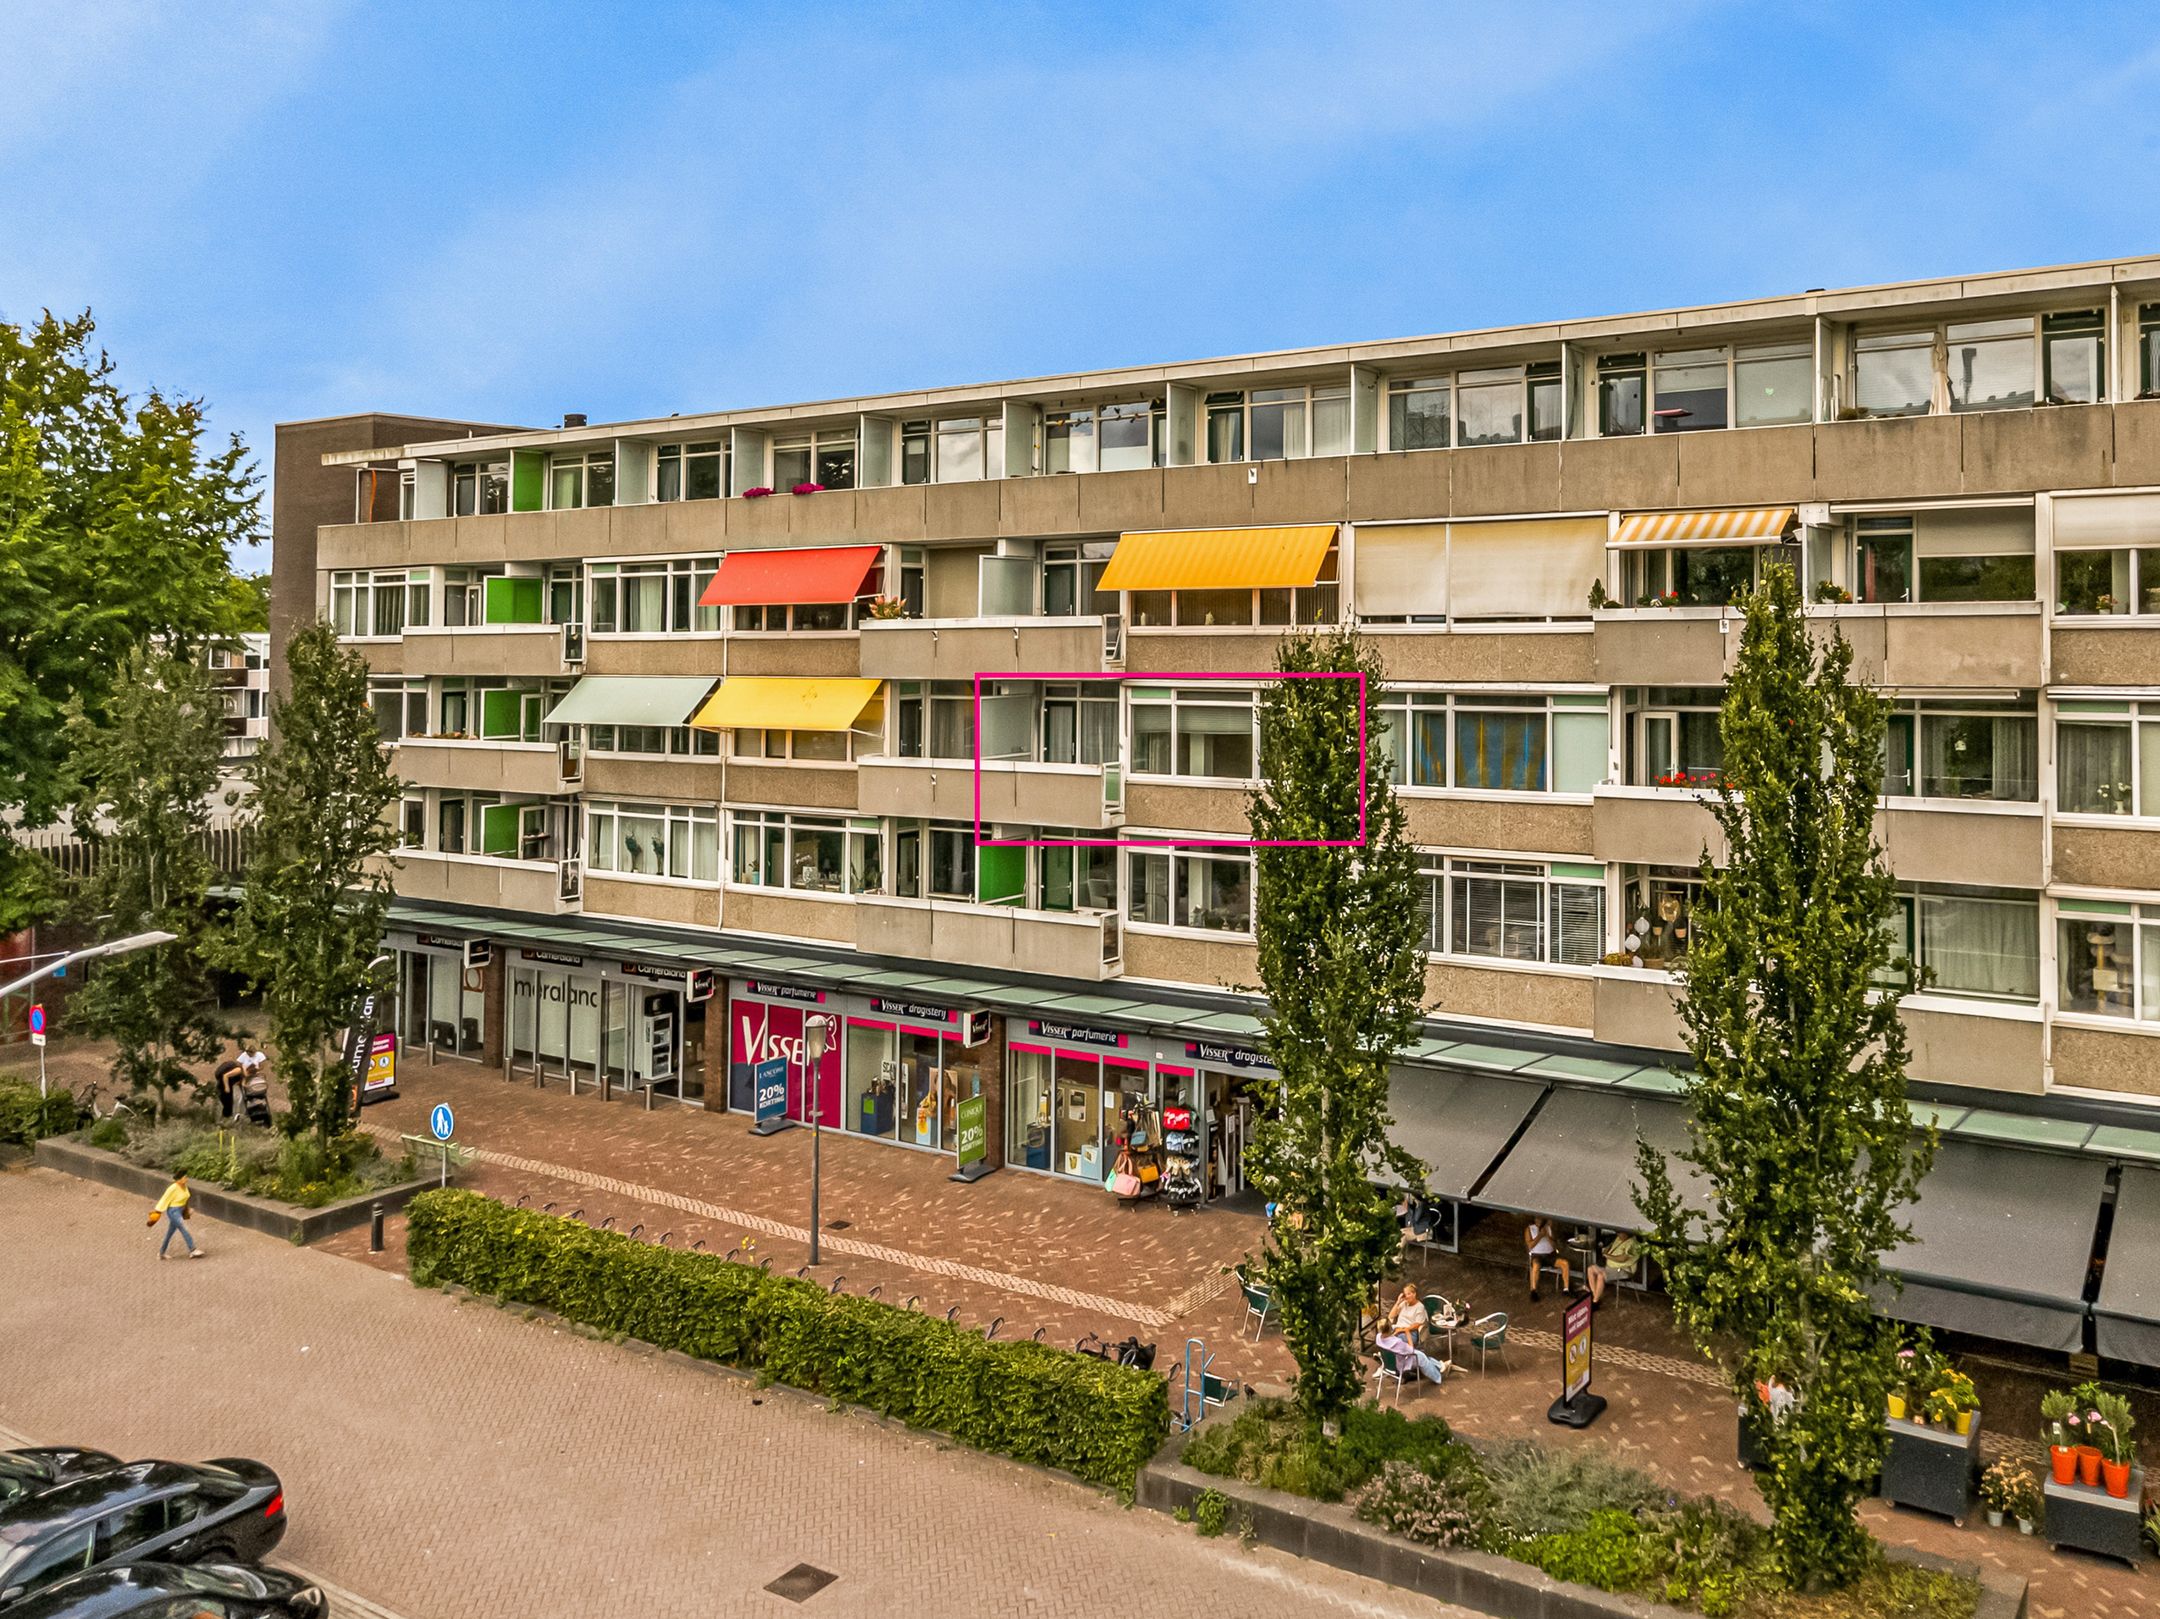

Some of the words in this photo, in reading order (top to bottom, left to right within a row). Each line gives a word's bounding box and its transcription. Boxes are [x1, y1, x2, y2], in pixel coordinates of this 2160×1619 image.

[637, 964, 686, 979] Cameraland
[1071, 1027, 1117, 1043] parfumerie
[759, 1082, 785, 1102] 20%
[961, 1123, 984, 1145] 20%
